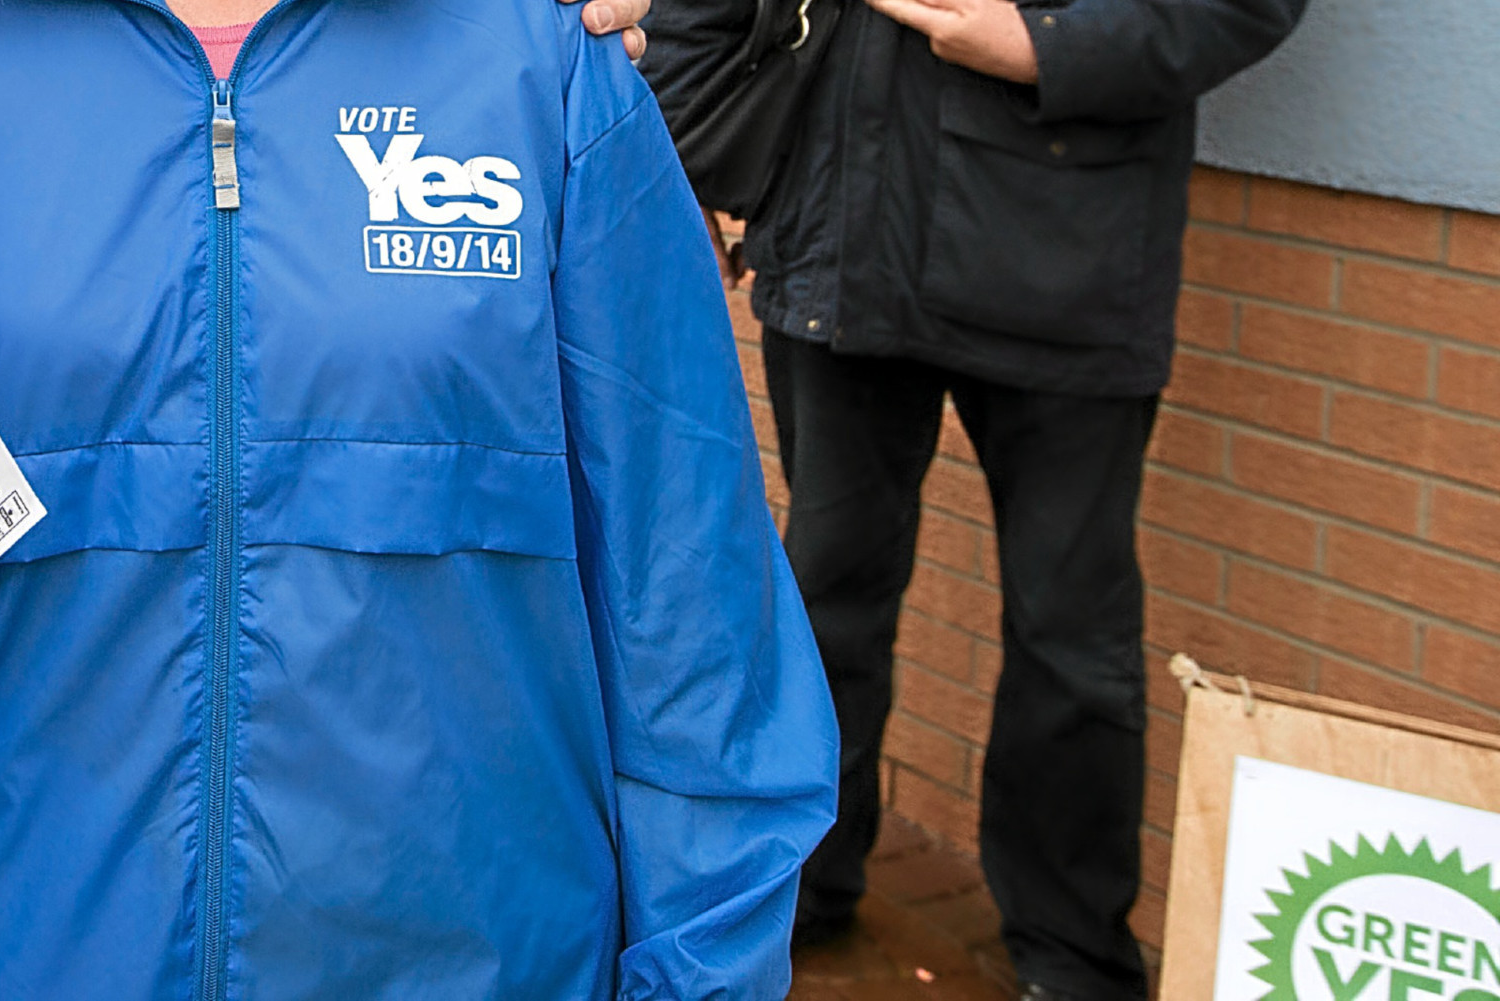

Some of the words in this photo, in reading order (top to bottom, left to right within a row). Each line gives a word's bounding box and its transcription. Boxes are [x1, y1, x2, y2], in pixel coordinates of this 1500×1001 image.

[339, 107, 417, 132] VOTE
[334, 134, 523, 226] Yes
[372, 233, 511, 272] 18/9/14
[1316, 904, 1500, 987] GREEN
